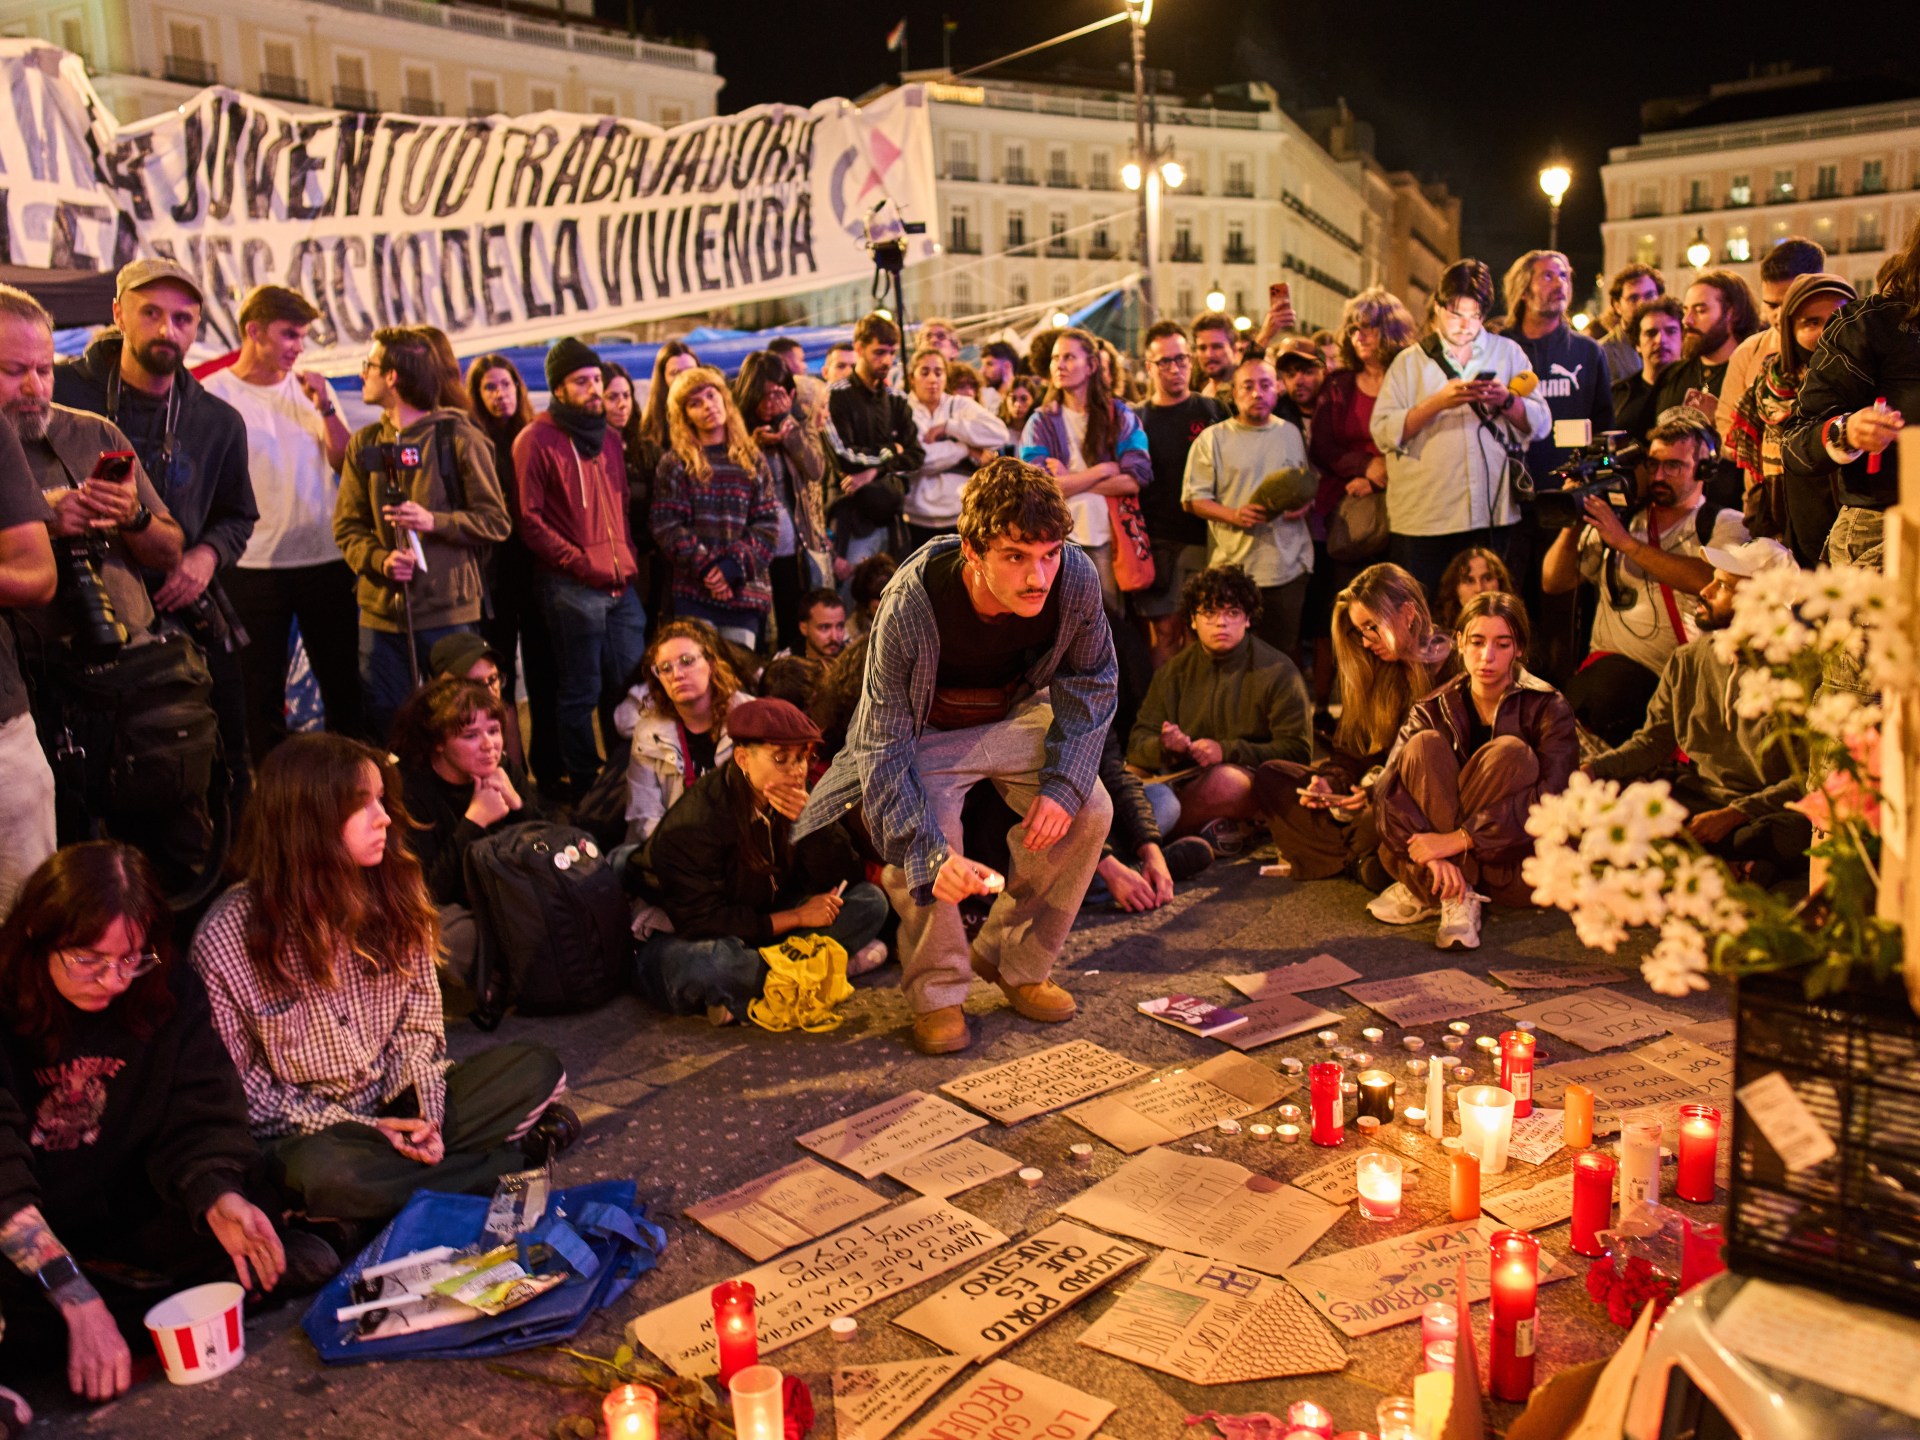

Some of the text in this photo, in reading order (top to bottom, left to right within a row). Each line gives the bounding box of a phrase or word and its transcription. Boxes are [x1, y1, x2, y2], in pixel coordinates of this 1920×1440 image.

[170, 96, 493, 222] JUVENTUD
[488, 113, 823, 211] TRABAJADORA
[439, 222, 513, 334] DE
[520, 217, 590, 321] LA
[599, 191, 817, 307] VIVIENDA
[1539, 378, 1571, 397] UMA
[1539, 992, 1632, 1026] ALTO
[1593, 1013, 1672, 1038] VUELA
[995, 1048, 1104, 1088] zapatillas,
[1030, 1042, 1090, 1064] calor,
[1652, 1046, 1690, 1064] NOS
[1681, 1055, 1720, 1073] POR
[982, 1054, 1117, 1107] una almohada,
[1035, 1064, 1139, 1108] una cama, un
[1632, 1074, 1677, 1088] TODO
[985, 1094, 1036, 1112] agua,
[1593, 1076, 1740, 1120] UCHAREMOS
[901, 1143, 983, 1177] DIGNIDAD
[1127, 1162, 1202, 1213] INJUSTICIA
[1193, 1171, 1245, 1201] NI
[916, 1234, 940, 1248] LO
[937, 1219, 973, 1236] POR
[1238, 1210, 1309, 1255] QUEREMOS
[1399, 1226, 1478, 1258] LAZAS
[778, 1224, 896, 1274] TUYO
[787, 1211, 953, 1288] SEGUIRÁ SIENDO
[871, 1247, 913, 1272] QUE
[927, 1229, 990, 1261] VAMOS
[907, 1258, 924, 1272] A
[994, 1245, 1087, 1300] QUE ES
[806, 1270, 864, 1298] ERA,
[812, 1268, 903, 1317] SEGUIR
[980, 1245, 1133, 1342] LUCHAD POR LO
[1328, 1277, 1458, 1322] GORRIONES
[1106, 1318, 1182, 1356] GENTE
[1187, 1321, 1230, 1353] CASAS
[1170, 1349, 1207, 1377] SIN
